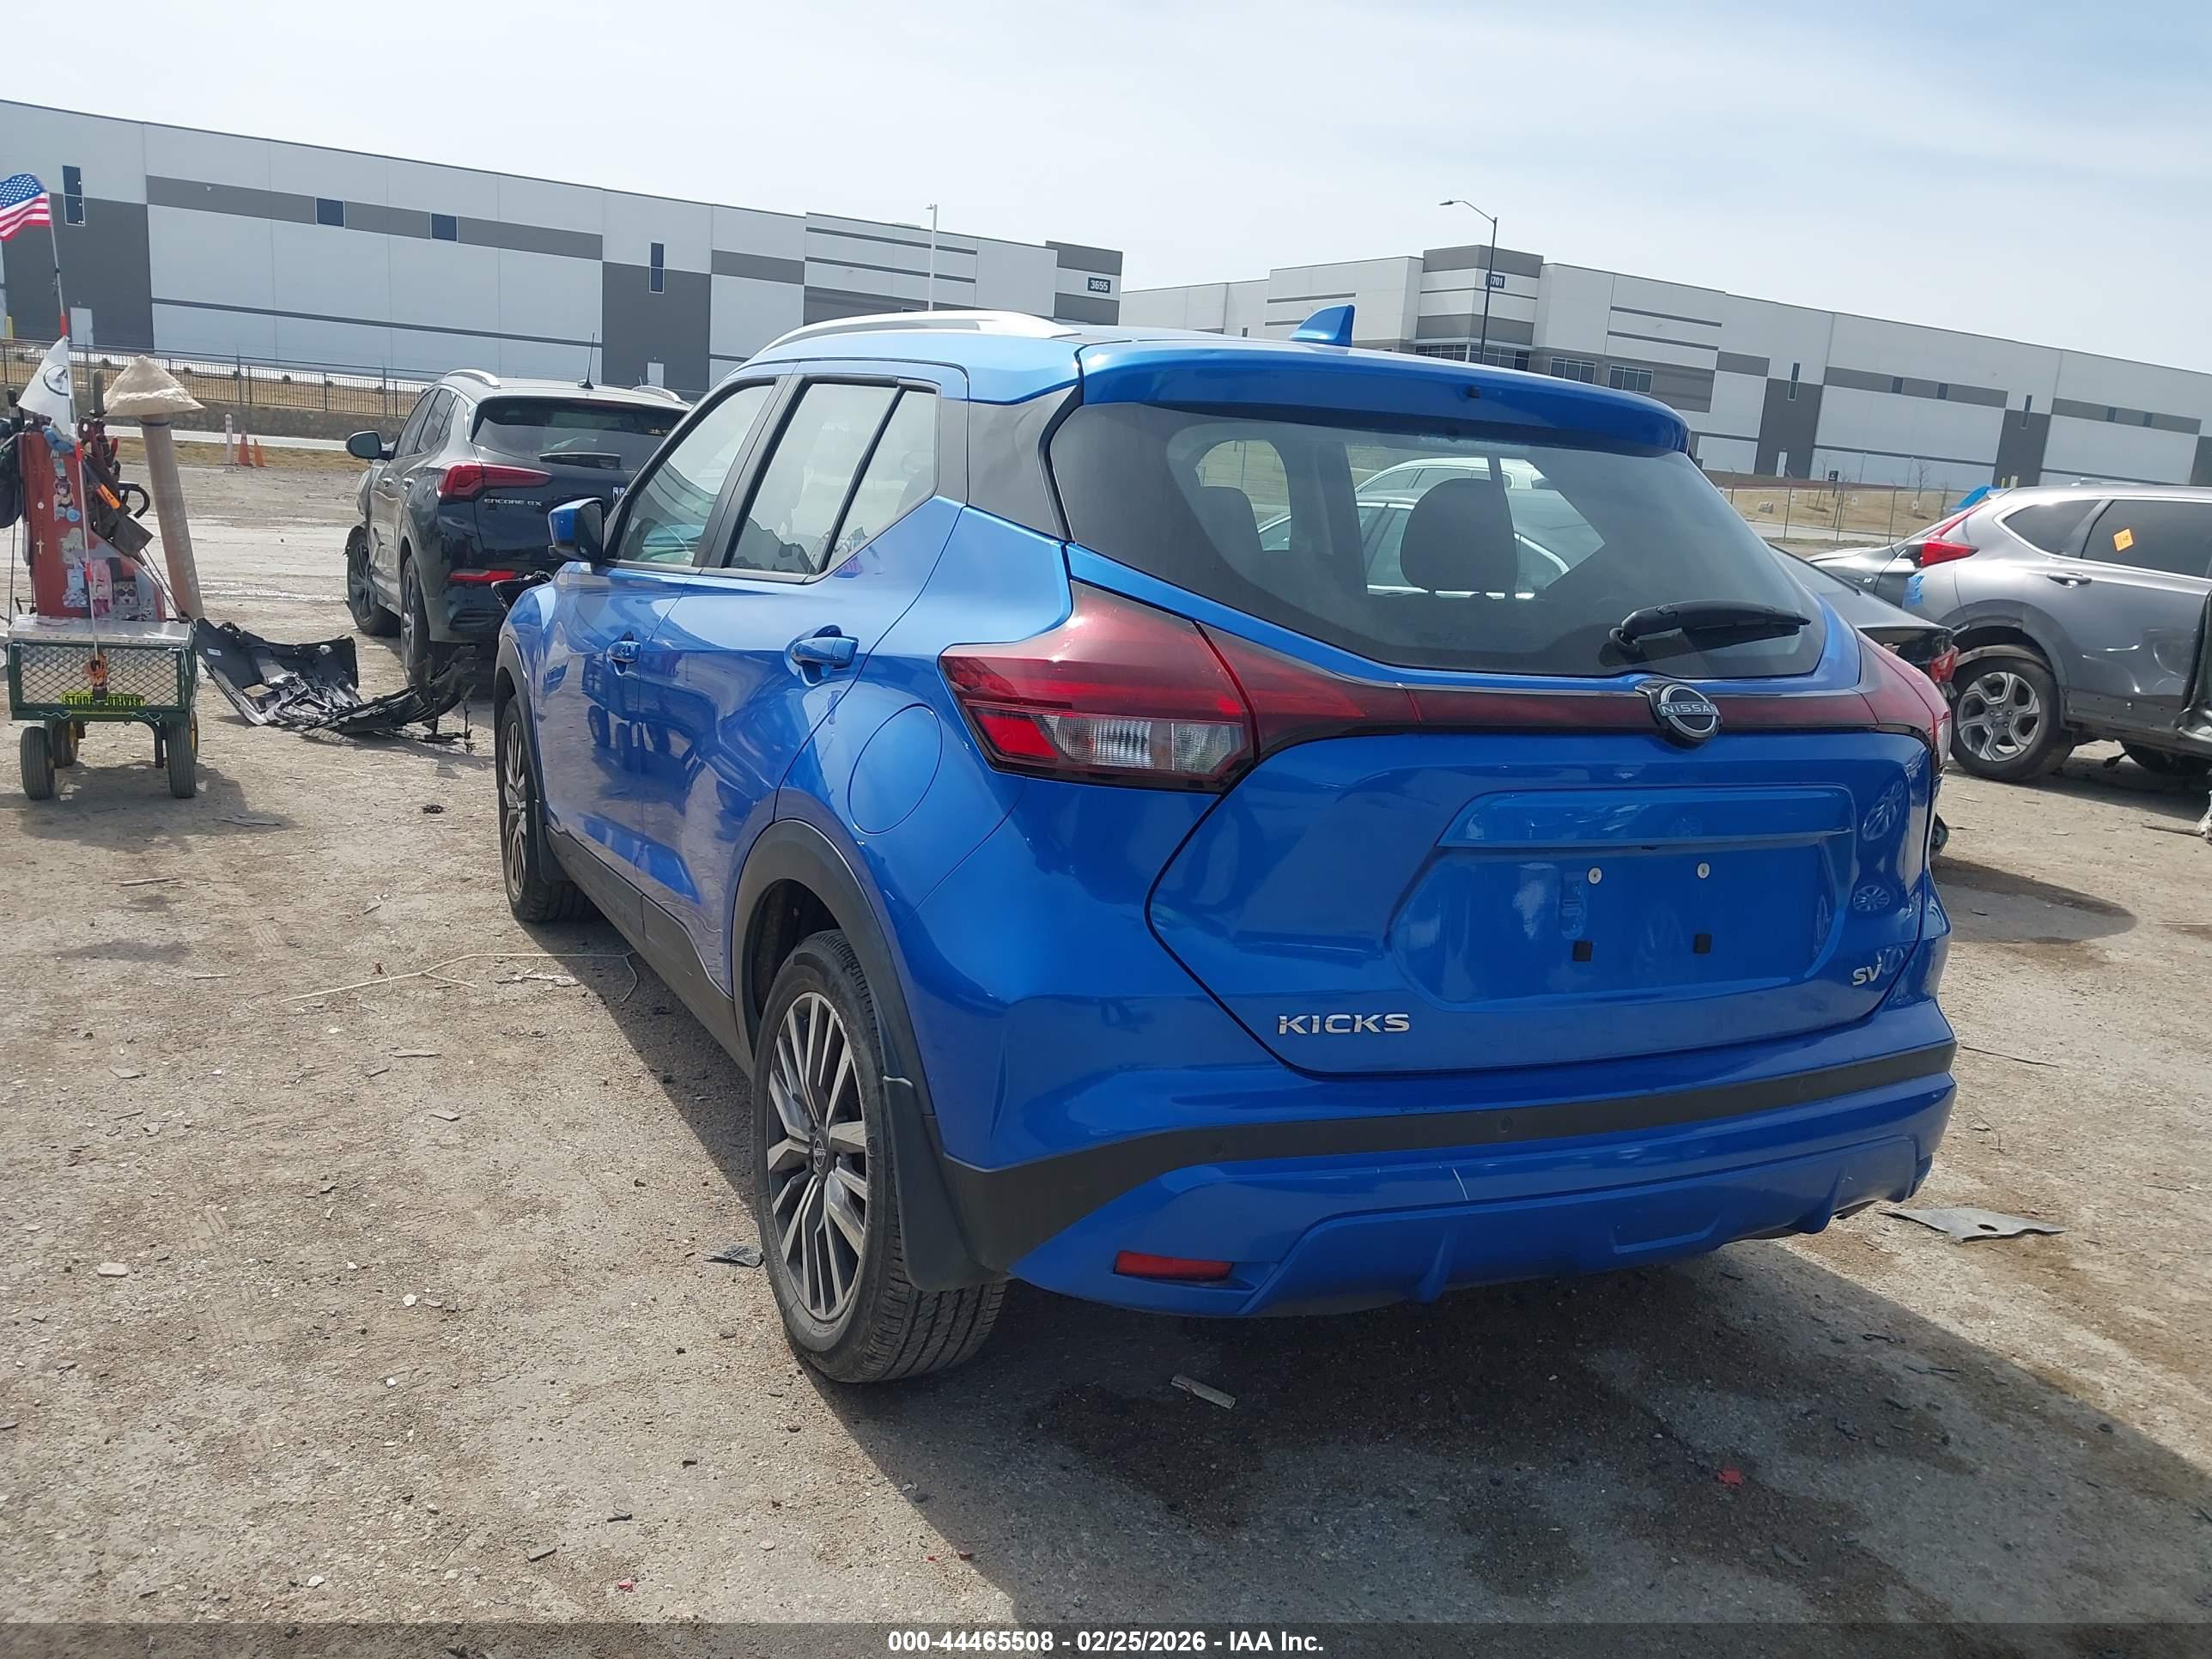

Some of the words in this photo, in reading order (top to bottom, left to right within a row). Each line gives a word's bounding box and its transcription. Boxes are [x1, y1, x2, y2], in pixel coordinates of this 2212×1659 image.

[1091, 279, 1109, 291] 3655
[1489, 275, 1504, 287] 701
[1662, 704, 1717, 714] NISSAN
[1852, 964, 1882, 986] SV
[1278, 1013, 1411, 1035] KICKS
